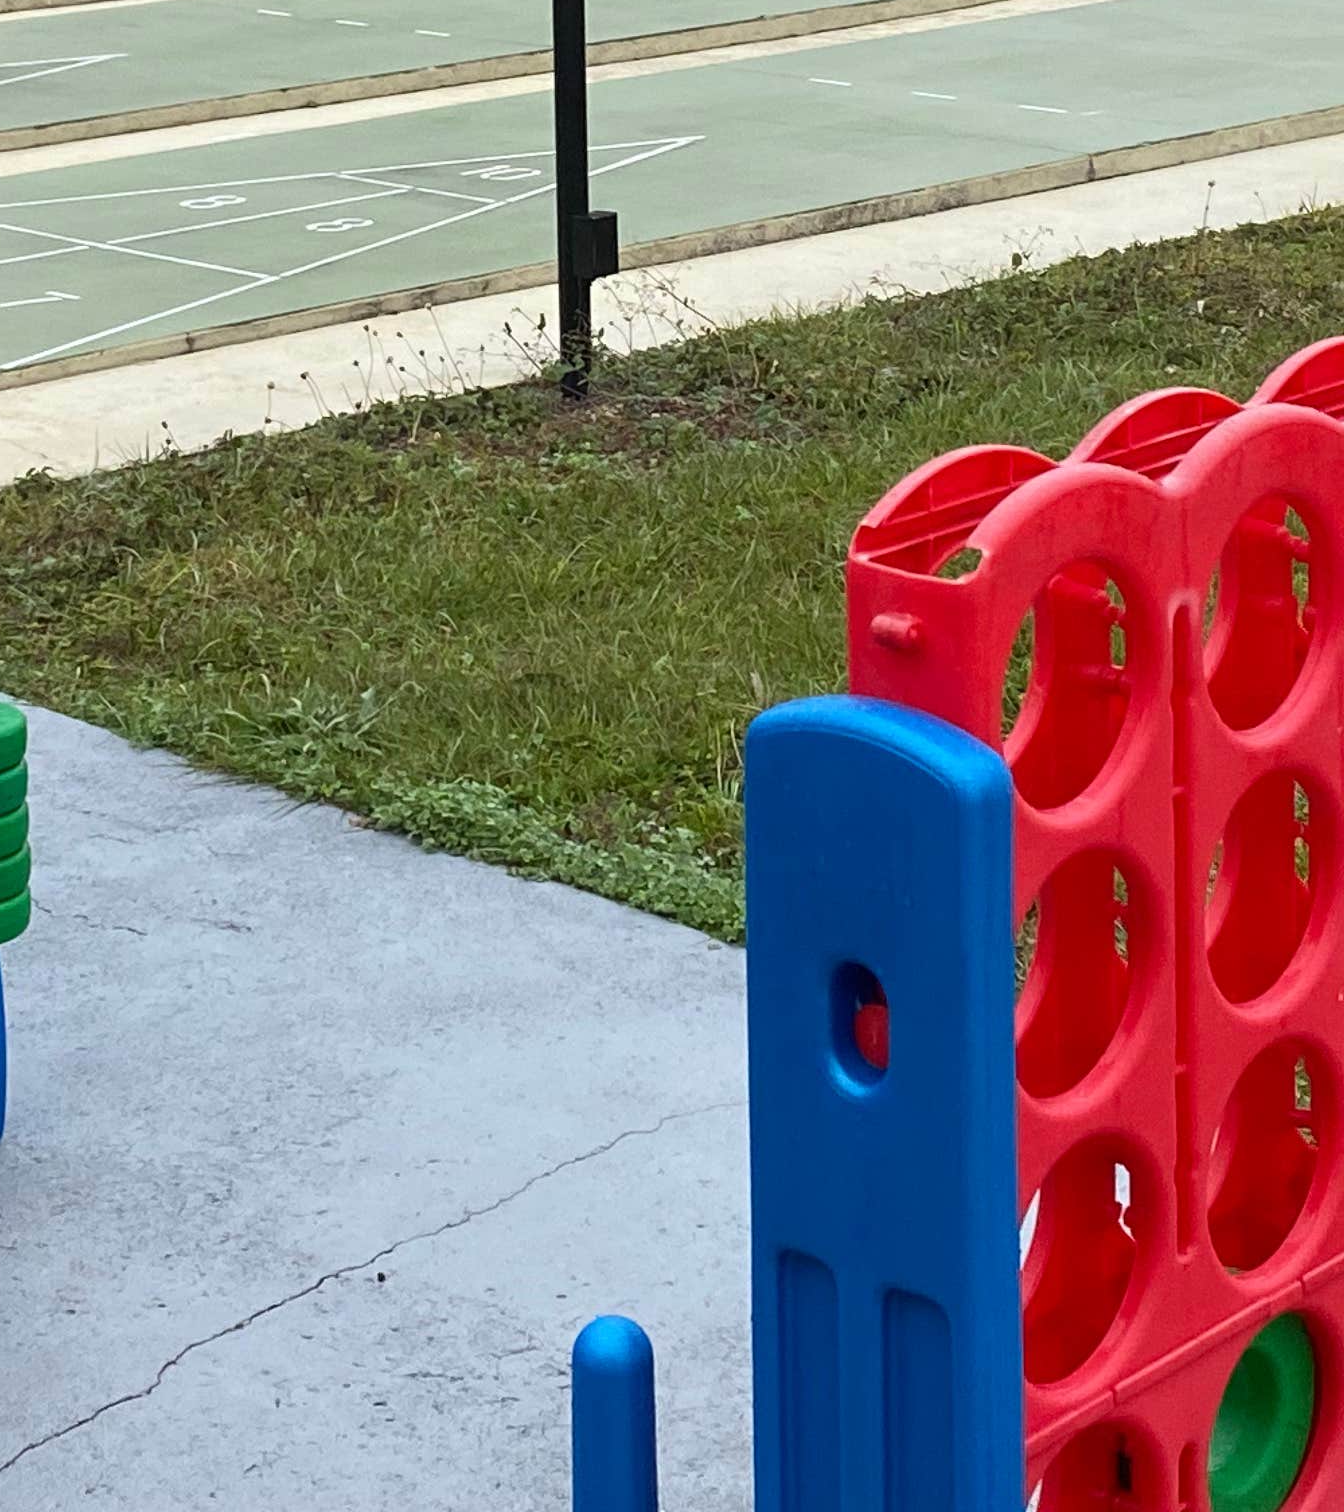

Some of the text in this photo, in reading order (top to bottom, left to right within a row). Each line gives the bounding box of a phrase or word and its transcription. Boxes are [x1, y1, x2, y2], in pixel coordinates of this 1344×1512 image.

[459, 165, 542, 181] 10
[179, 194, 247, 209] 8
[305, 218, 374, 232] 8
